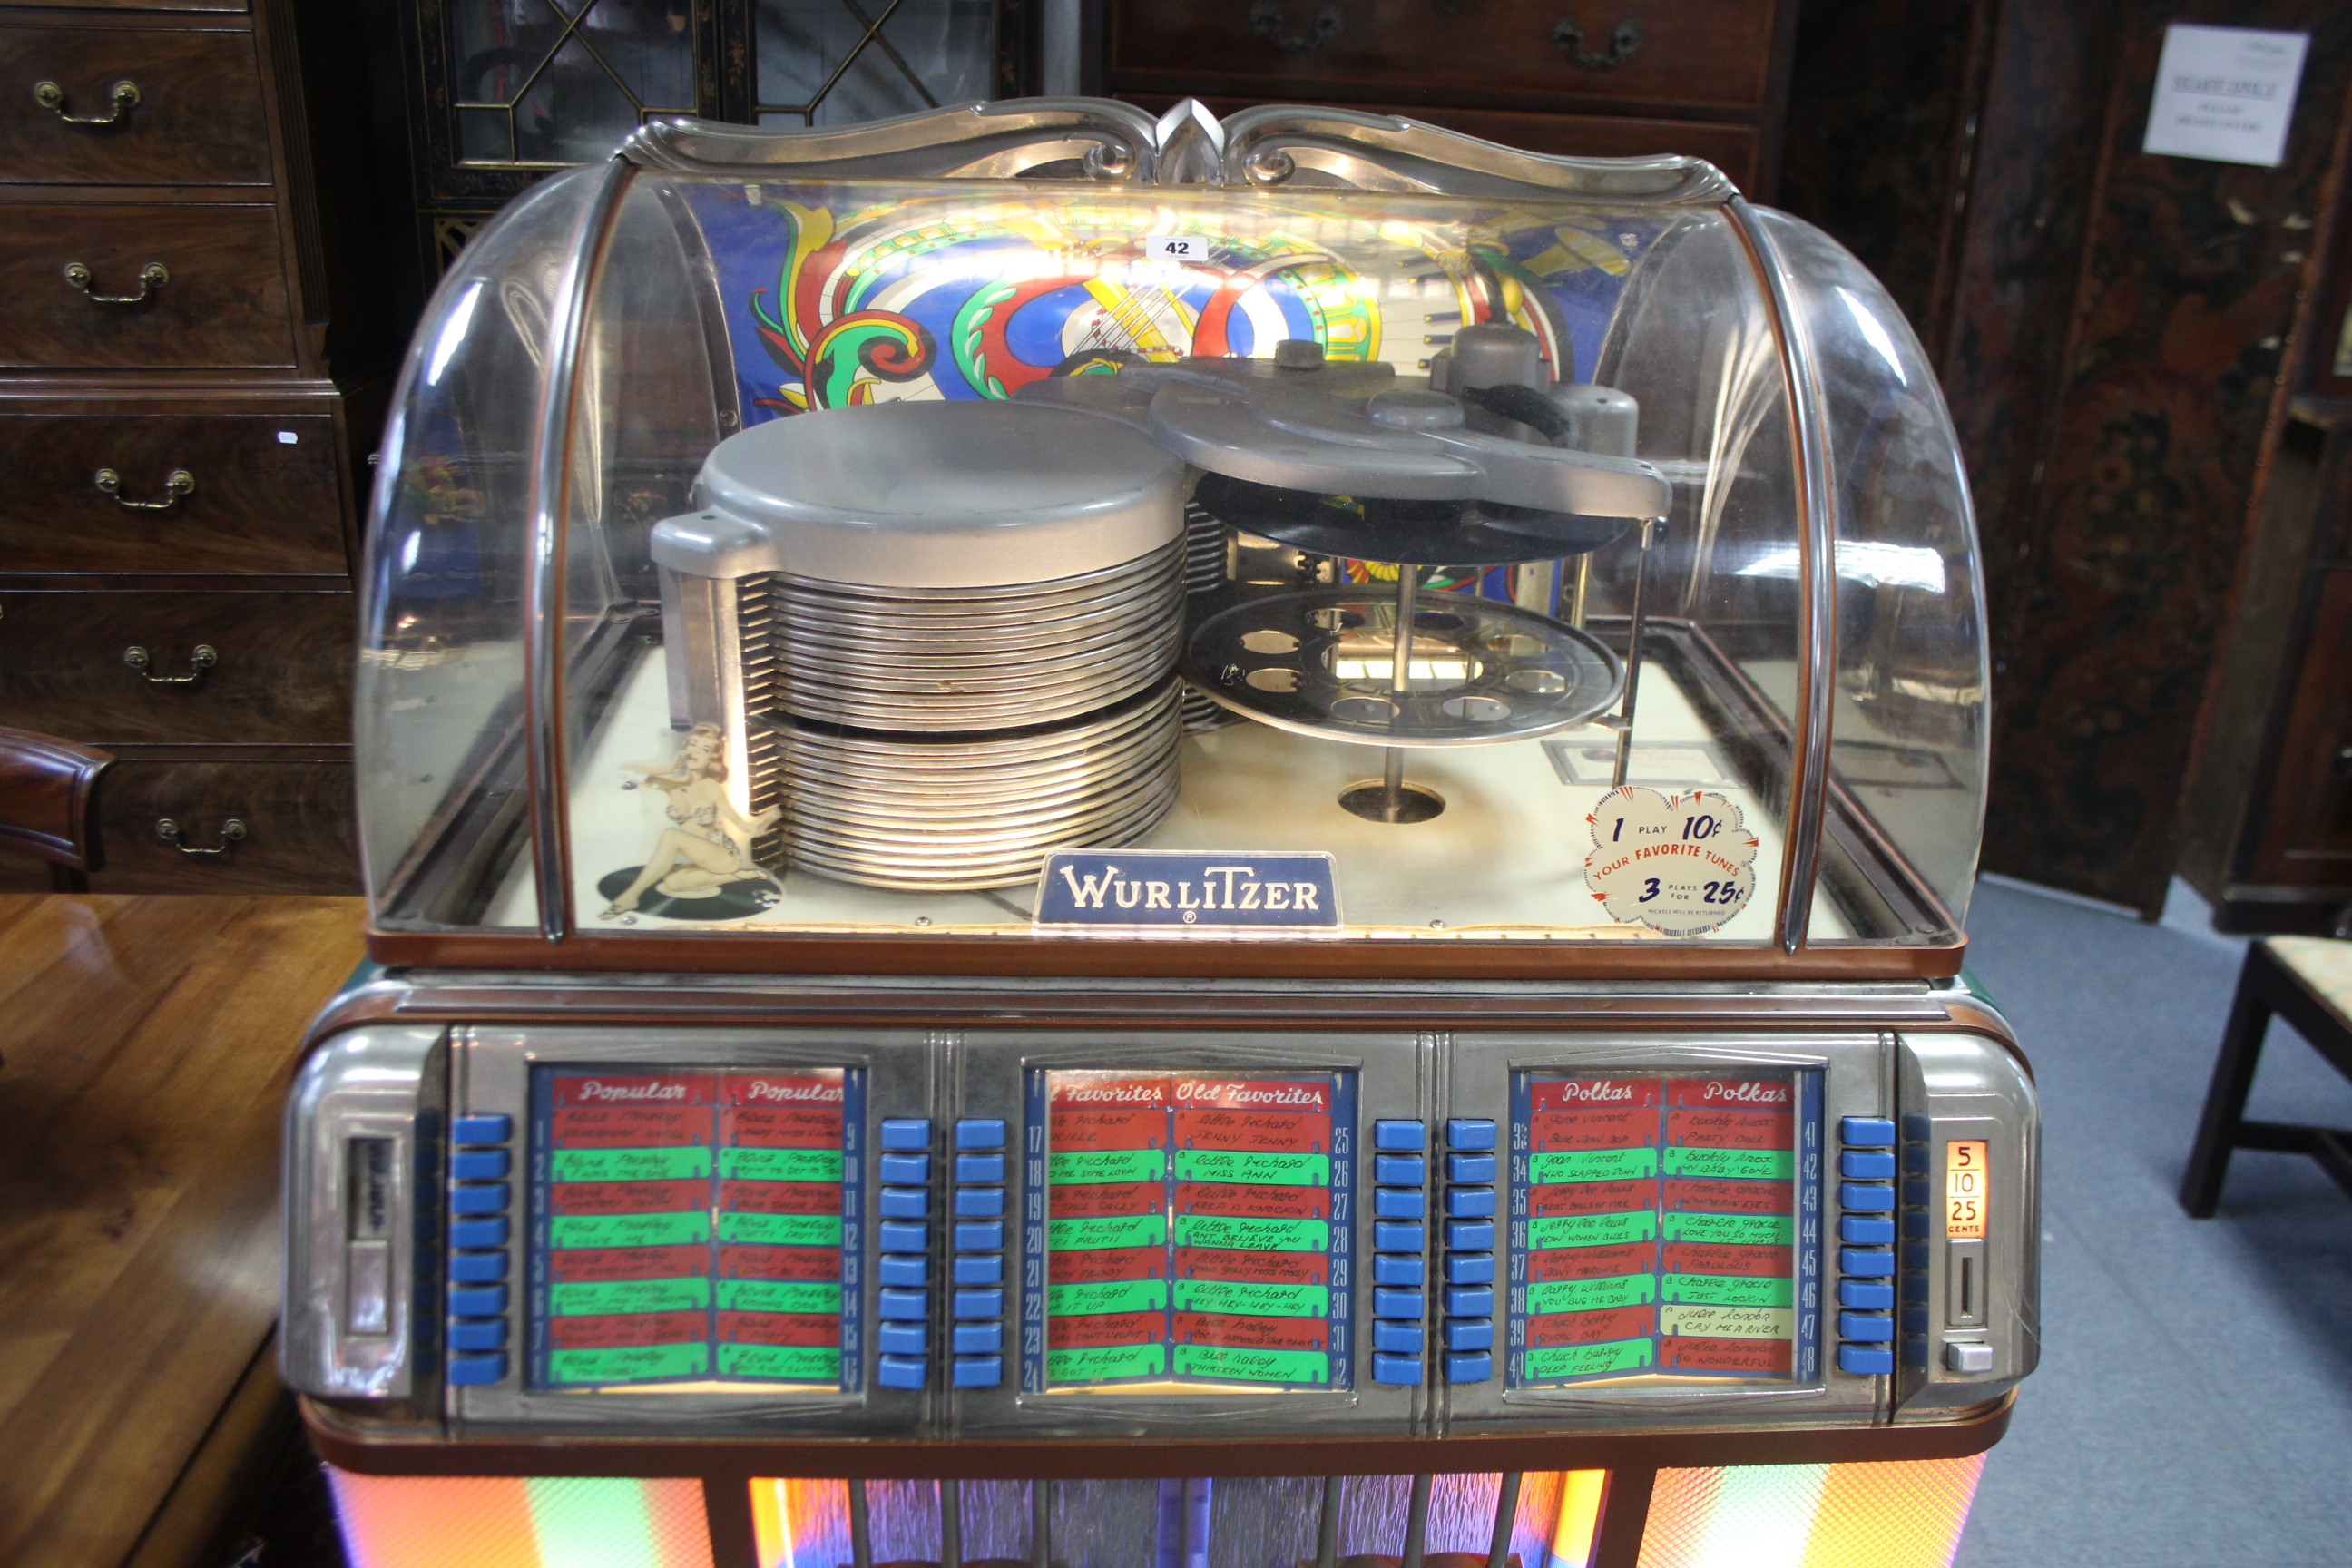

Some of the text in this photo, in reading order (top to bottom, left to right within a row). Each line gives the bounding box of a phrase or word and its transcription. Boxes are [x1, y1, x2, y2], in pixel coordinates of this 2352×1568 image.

[1165, 242, 1190, 254] 42
[1612, 815, 1723, 842] 1 PLAY 10¢
[1593, 844, 1740, 881] YOUR FAVORITE TUNES
[1638, 877, 1745, 905] 3 PLAYS 25¢
[578, 1080, 687, 1101] Popular
[748, 1080, 844, 1102] Popular
[1066, 1084, 1162, 1102] Favorites
[1176, 1083, 1324, 1105] Old Favorites
[1563, 1081, 1632, 1101] Polkas
[1703, 1081, 1788, 1102] Polkas
[1028, 1126, 1043, 1153] 17
[1335, 1127, 1349, 1154] 25
[1805, 1122, 1815, 1148] 41
[1513, 1155, 1526, 1182] 34
[1803, 1153, 1818, 1180] 42
[1958, 1146, 1971, 1167] 5
[1028, 1159, 1042, 1187] 18
[1334, 1161, 1349, 1187] 26
[1955, 1173, 1974, 1193] 10
[845, 1190, 857, 1217] 11
[1027, 1192, 1041, 1220] 19
[1334, 1194, 1348, 1220] 27
[1513, 1189, 1526, 1215] 35
[1802, 1186, 1817, 1211] 43
[1952, 1201, 1976, 1221] 25
[844, 1223, 858, 1251] 12
[1026, 1226, 1042, 1254] 20
[1333, 1226, 1348, 1253] 28
[1512, 1221, 1526, 1248] 36
[1802, 1219, 1817, 1244] 44
[1948, 1225, 1980, 1233] CENTS
[844, 1257, 858, 1284] 13
[1026, 1259, 1039, 1288] 21
[1333, 1259, 1348, 1287] 29
[1511, 1254, 1525, 1280] 37
[1801, 1250, 1816, 1276] 45
[844, 1290, 858, 1318] 14
[1025, 1293, 1041, 1320] 22
[1332, 1292, 1347, 1319] 30
[1511, 1287, 1524, 1313] 38
[1801, 1282, 1815, 1308] 46
[1333, 1326, 1345, 1352] 31
[1801, 1314, 1815, 1340] 47
[1025, 1327, 1039, 1354] 23
